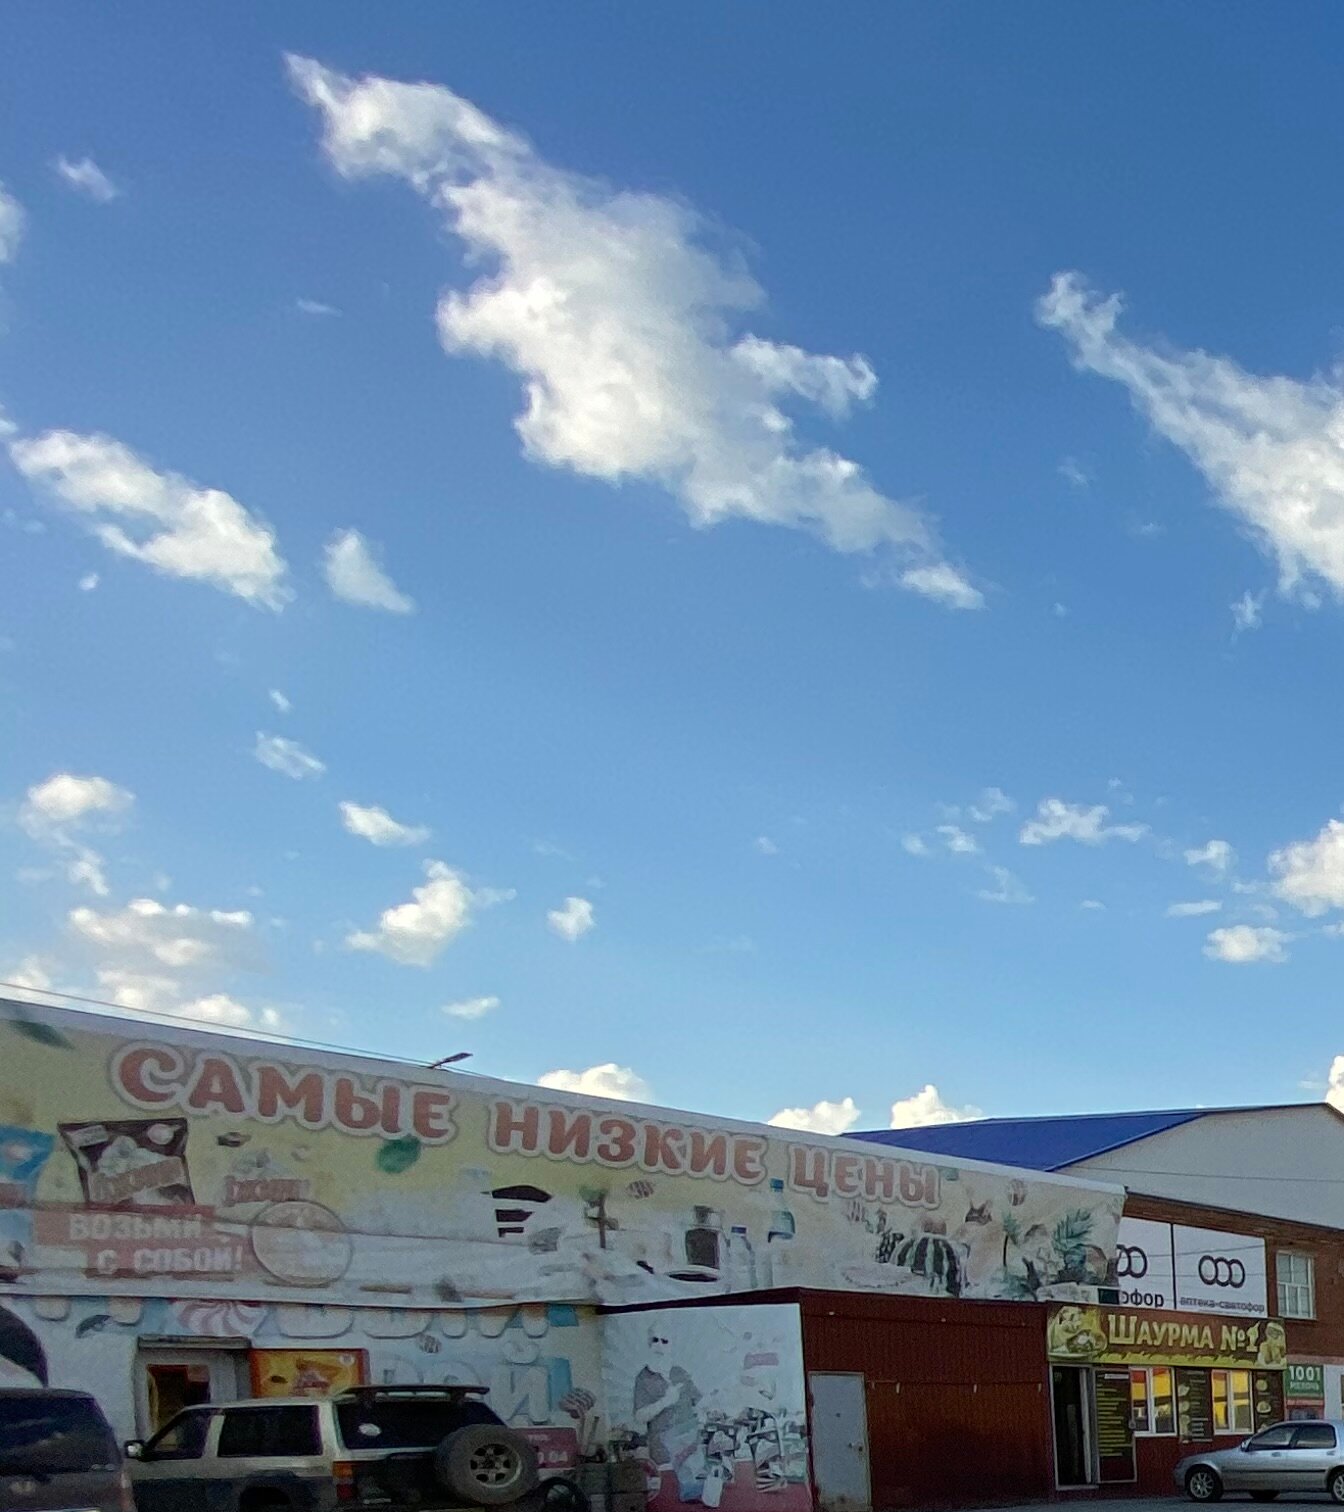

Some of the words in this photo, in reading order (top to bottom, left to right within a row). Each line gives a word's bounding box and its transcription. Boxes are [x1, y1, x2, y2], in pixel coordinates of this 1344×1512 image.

[118, 1046, 452, 1139] САМЫЕ
[495, 1102, 763, 1179] НИЗКИЕ
[794, 1146, 938, 1202] ЦЕНЫ
[69, 1211, 202, 1241] ВОЗЬМИ
[1107, 1314, 1215, 1350] ШАУРМА
[1220, 1321, 1261, 1352] №1
[1289, 1365, 1321, 1381] 1001
